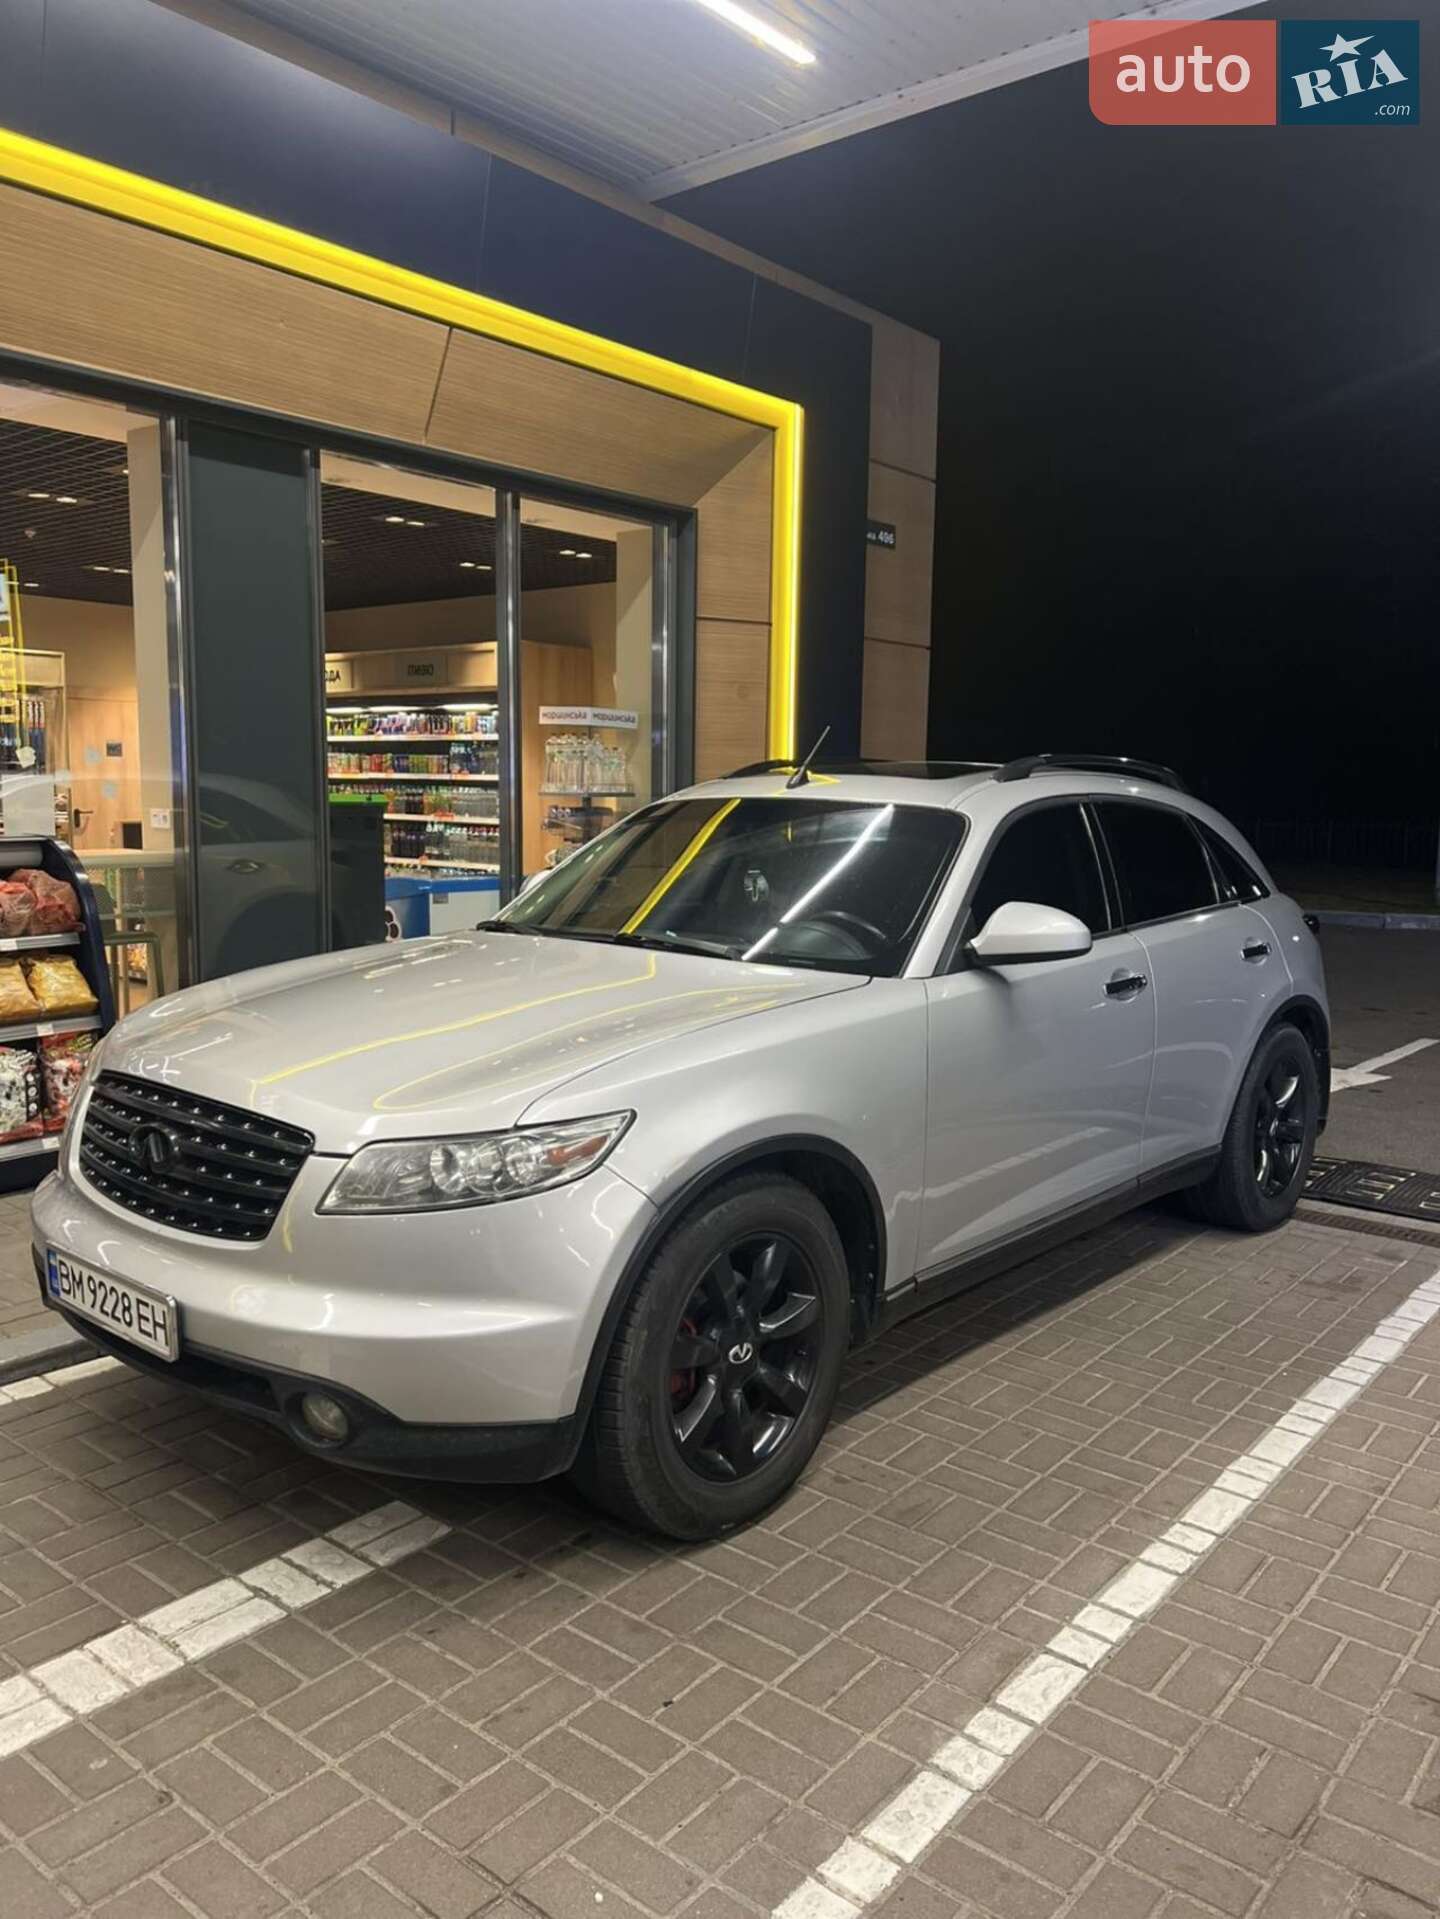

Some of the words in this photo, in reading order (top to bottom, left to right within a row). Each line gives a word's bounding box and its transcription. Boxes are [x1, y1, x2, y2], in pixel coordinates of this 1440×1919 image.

[58, 1260, 86, 1304] BM
[87, 1275, 134, 1328] 9228
[136, 1297, 169, 1347] EH
